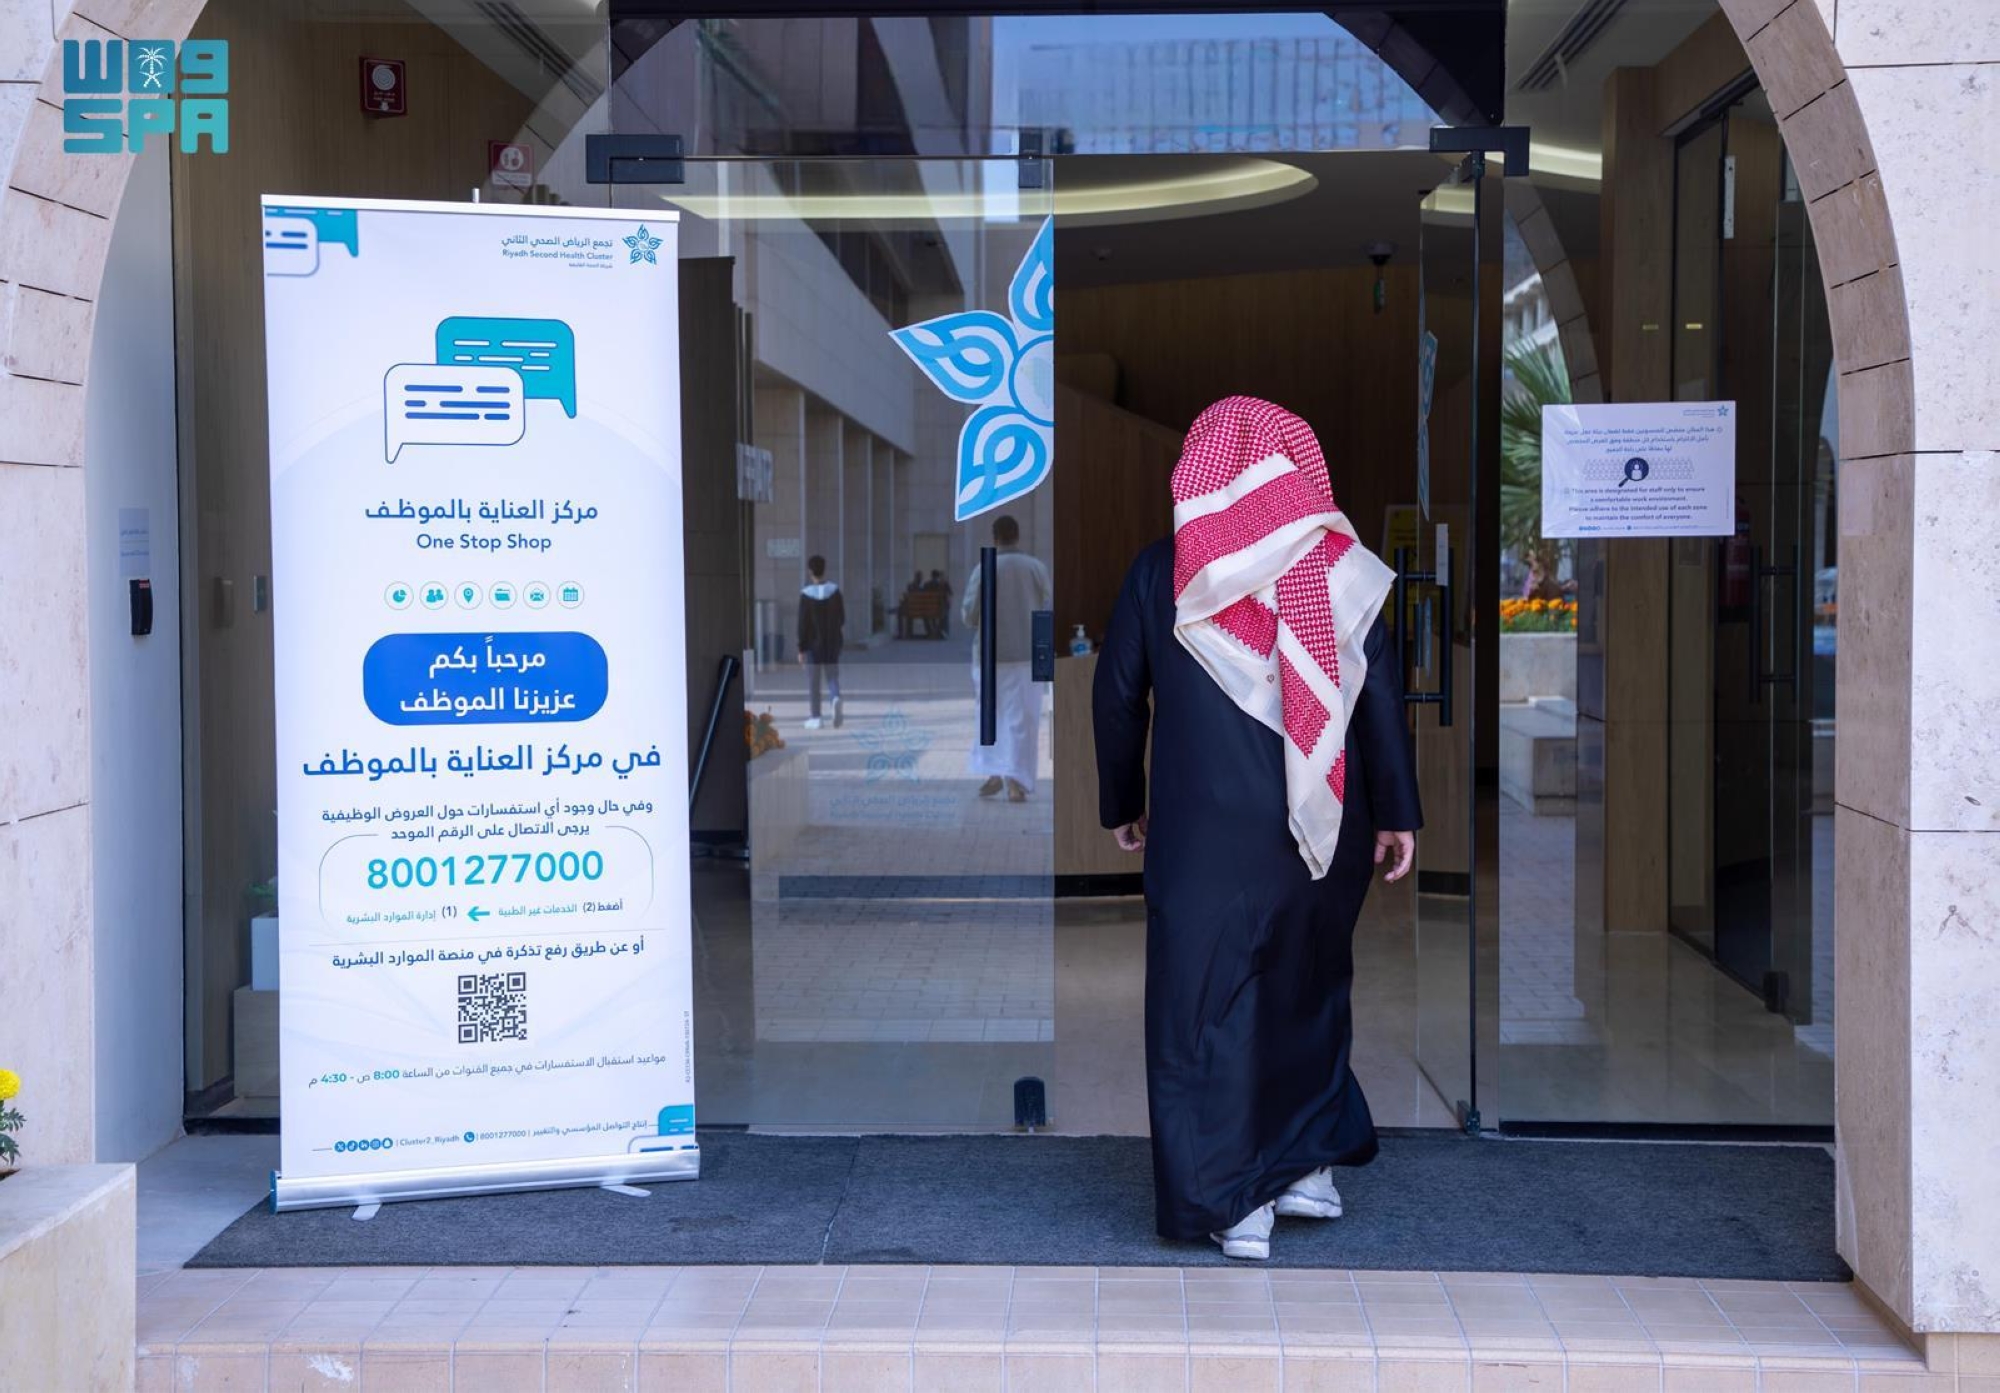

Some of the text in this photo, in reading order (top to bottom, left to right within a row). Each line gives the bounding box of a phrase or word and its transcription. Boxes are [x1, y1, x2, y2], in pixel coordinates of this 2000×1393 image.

[501, 233, 614, 250] تجمع الرياض الصحي الثاني
[502, 248, 529, 260] Riyadh
[529, 250, 558, 260] Second
[559, 251, 586, 260] Health
[364, 497, 600, 526] مركز العناية بالموظف
[416, 532, 553, 553] One Stop Shop
[428, 645, 478, 680] بكم
[400, 686, 577, 718] عزيزنا الموظف
[302, 743, 662, 782] في مركز العناية بالموظف
[321, 796, 654, 824] وفي حال وجود أي استفسارات حول العروض الوظيفية
[390, 821, 591, 843] يرجى الاتصال على الرقم الموحد
[368, 850, 603, 889] 8001277000
[383, 910, 416, 923] الموارد
[441, 904, 458, 920] (1)
[498, 906, 527, 919] الطبية
[528, 906, 543, 918] غير
[543, 903, 578, 915] الخدمات
[346, 911, 382, 926] البشرية
[331, 935, 645, 970] أو عن طريق رفع تذكرة في منصة الموارد البشرية
[533, 1056, 596, 1073] الاستفسارات
[597, 1054, 636, 1069] استقبال
[636, 1052, 667, 1065] مواعيد
[373, 1069, 400, 1081] 8:00
[402, 1067, 434, 1079] الساعة
[435, 1068, 451, 1080] من
[452, 1063, 490, 1077] القنوات
[489, 1063, 514, 1078] جميع
[513, 1062, 534, 1075] في
[308, 1077, 319, 1089] م
[320, 1072, 348, 1084] 4:30
[356, 1073, 372, 1085] ص
